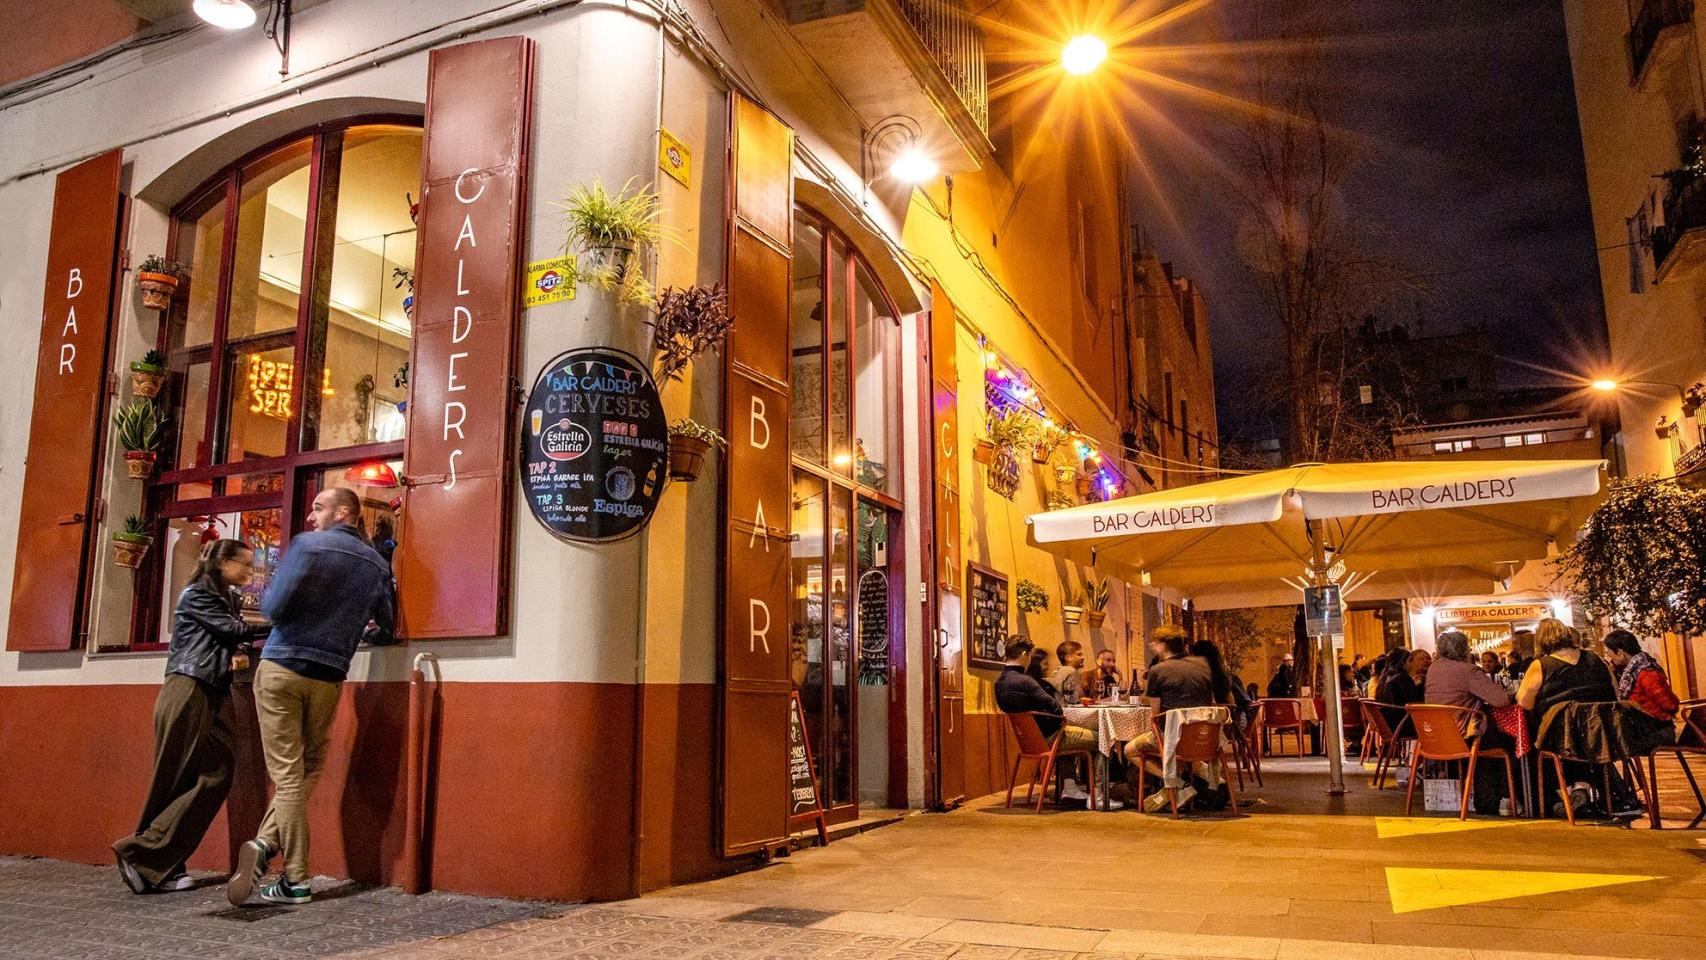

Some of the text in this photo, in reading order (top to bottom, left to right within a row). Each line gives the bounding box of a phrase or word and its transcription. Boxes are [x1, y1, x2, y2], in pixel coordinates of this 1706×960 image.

[536, 275, 564, 288] SPITZ
[527, 296, 536, 304] 93
[59, 267, 83, 375] BAR
[443, 167, 486, 491] CALDERS
[553, 376, 637, 395] BAR CALDERS
[544, 393, 650, 419] CERVESES
[547, 431, 585, 442] Estrella
[603, 421, 629, 437] TAP
[547, 441, 583, 452] Galicia
[603, 434, 640, 448] ESTRELLA
[528, 461, 557, 476] TAP 2
[553, 474, 580, 482] GARAGE
[554, 481, 569, 491] pale
[570, 481, 582, 489] ale
[1372, 477, 1516, 508] BAR CALDERS
[536, 494, 564, 506] TAP 3
[565, 504, 589, 512] BLONDE
[593, 499, 645, 518] Espiga
[749, 395, 770, 654] BAR
[1093, 504, 1214, 533] BAR CALDERS
[941, 422, 956, 734] CALDRS
[1440, 607, 1535, 619] LLIBRERIA CALDERS
